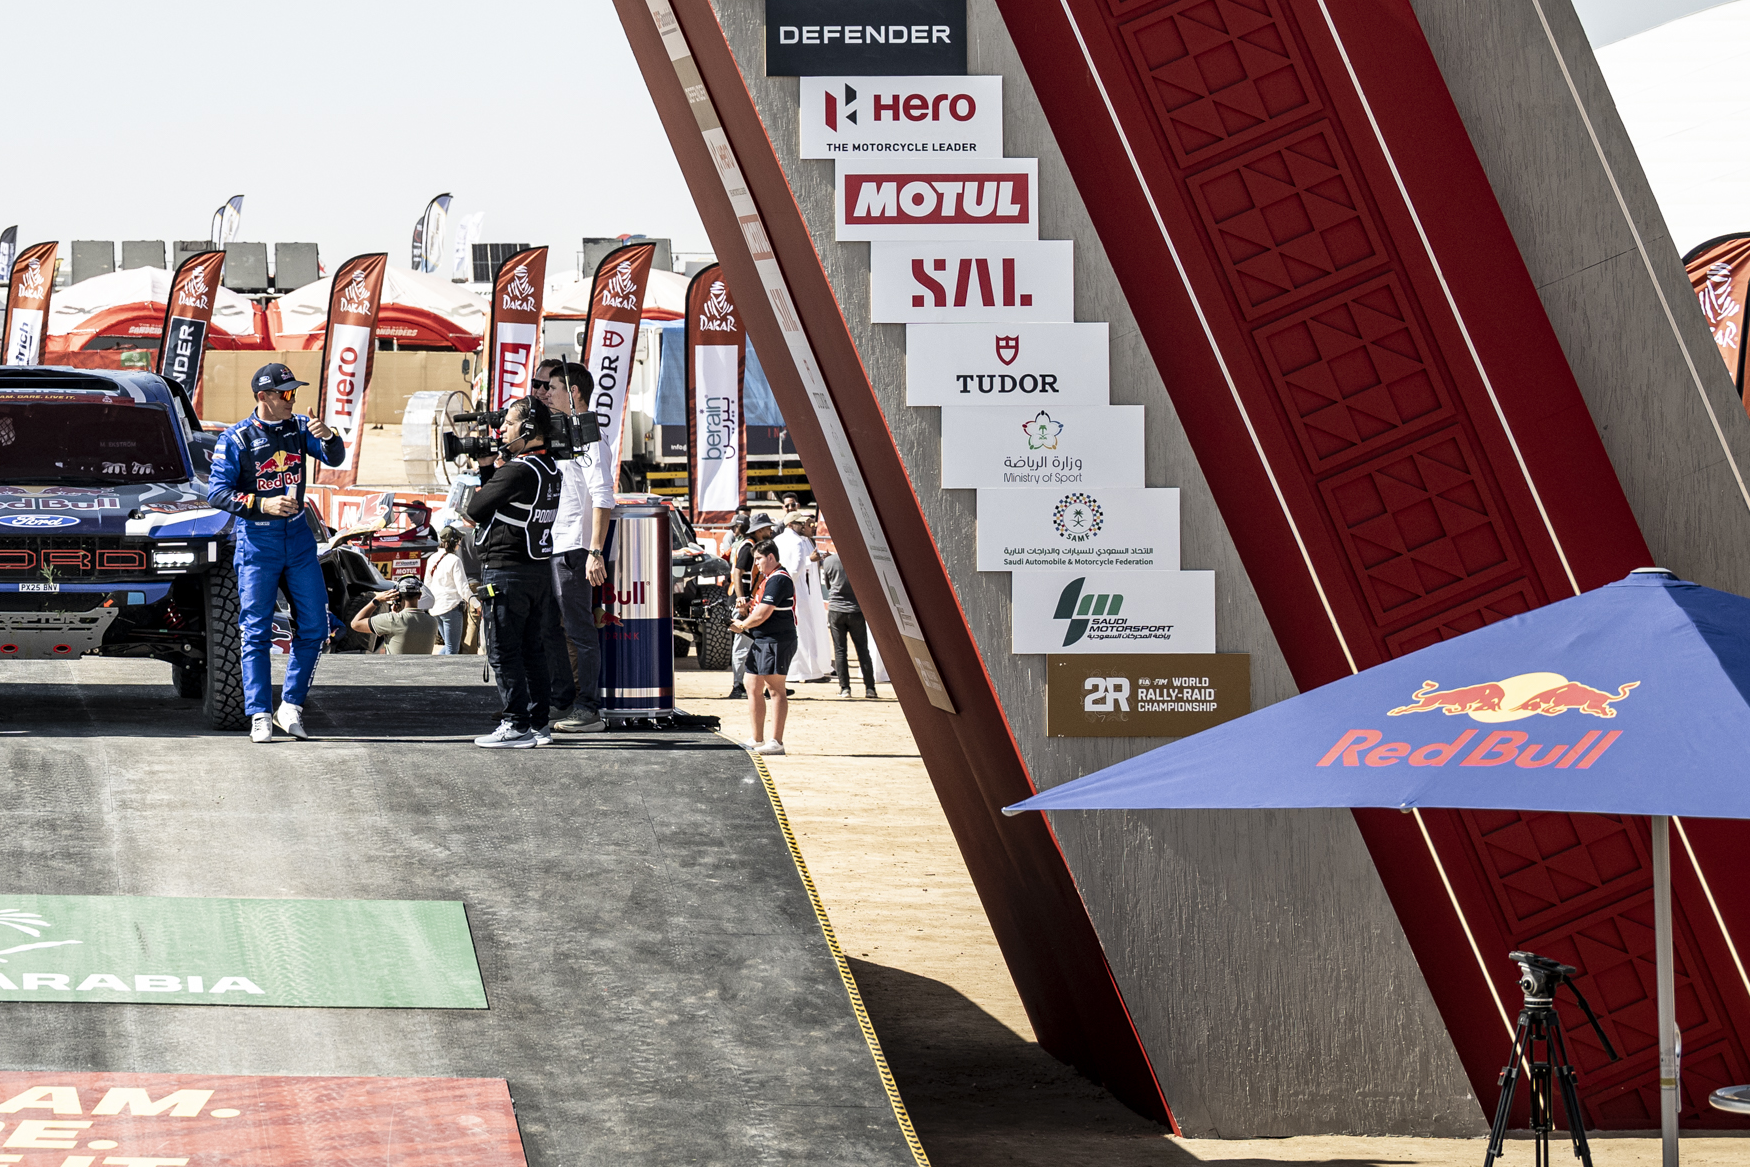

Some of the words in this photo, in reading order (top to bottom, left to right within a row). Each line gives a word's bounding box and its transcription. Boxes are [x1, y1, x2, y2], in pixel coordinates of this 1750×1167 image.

[779, 25, 952, 44] DEFENDER
[872, 92, 977, 122] Hero
[826, 143, 848, 152] THE
[852, 143, 928, 152] MOTORCYCLE
[932, 143, 977, 152] LEADER
[852, 181, 1022, 218] MOTUL
[18, 284, 44, 300] DAKAR
[178, 290, 210, 310] DAKAR
[340, 296, 371, 316] DAKAR
[502, 294, 536, 312] DAKAR
[602, 290, 638, 312] DAKAR
[699, 312, 738, 332] DAKAR
[376, 328, 418, 336] ANDRIDERS
[172, 324, 195, 385] NDER
[335, 346, 358, 417] Hero
[502, 348, 526, 404] TUL
[956, 374, 1060, 394] TUDOR
[596, 354, 620, 428] UDOR
[700, 396, 722, 460] berain
[1004, 456, 1048, 470] الرياضة
[1052, 456, 1082, 471] وزارة
[257, 472, 283, 490] Red
[284, 468, 302, 486] Bul
[1003, 472, 1040, 484] Ministry
[1042, 472, 1054, 483] of
[1056, 472, 1082, 484] Sport
[39, 498, 120, 510] Bull
[11, 516, 64, 526] Ford
[1066, 533, 1091, 544] SAMF
[1004, 546, 1026, 556] النارية
[1027, 546, 1062, 556] والدراجات
[1064, 546, 1096, 555] للسيارات
[1098, 546, 1130, 556] السعودي
[1075, 558, 1114, 567] Motorcycle
[602, 581, 645, 604] Bull
[605, 632, 640, 640] DRINK
[1088, 624, 1174, 632] MOTORSPORT
[1172, 677, 1210, 688] WORLD
[1084, 677, 1130, 712] 2R
[1138, 689, 1214, 700] RALLY-RAID
[1138, 702, 1218, 712] CHAMPIONSHIP
[1316, 729, 1479, 766] Red
[1460, 730, 1624, 769] Bull
